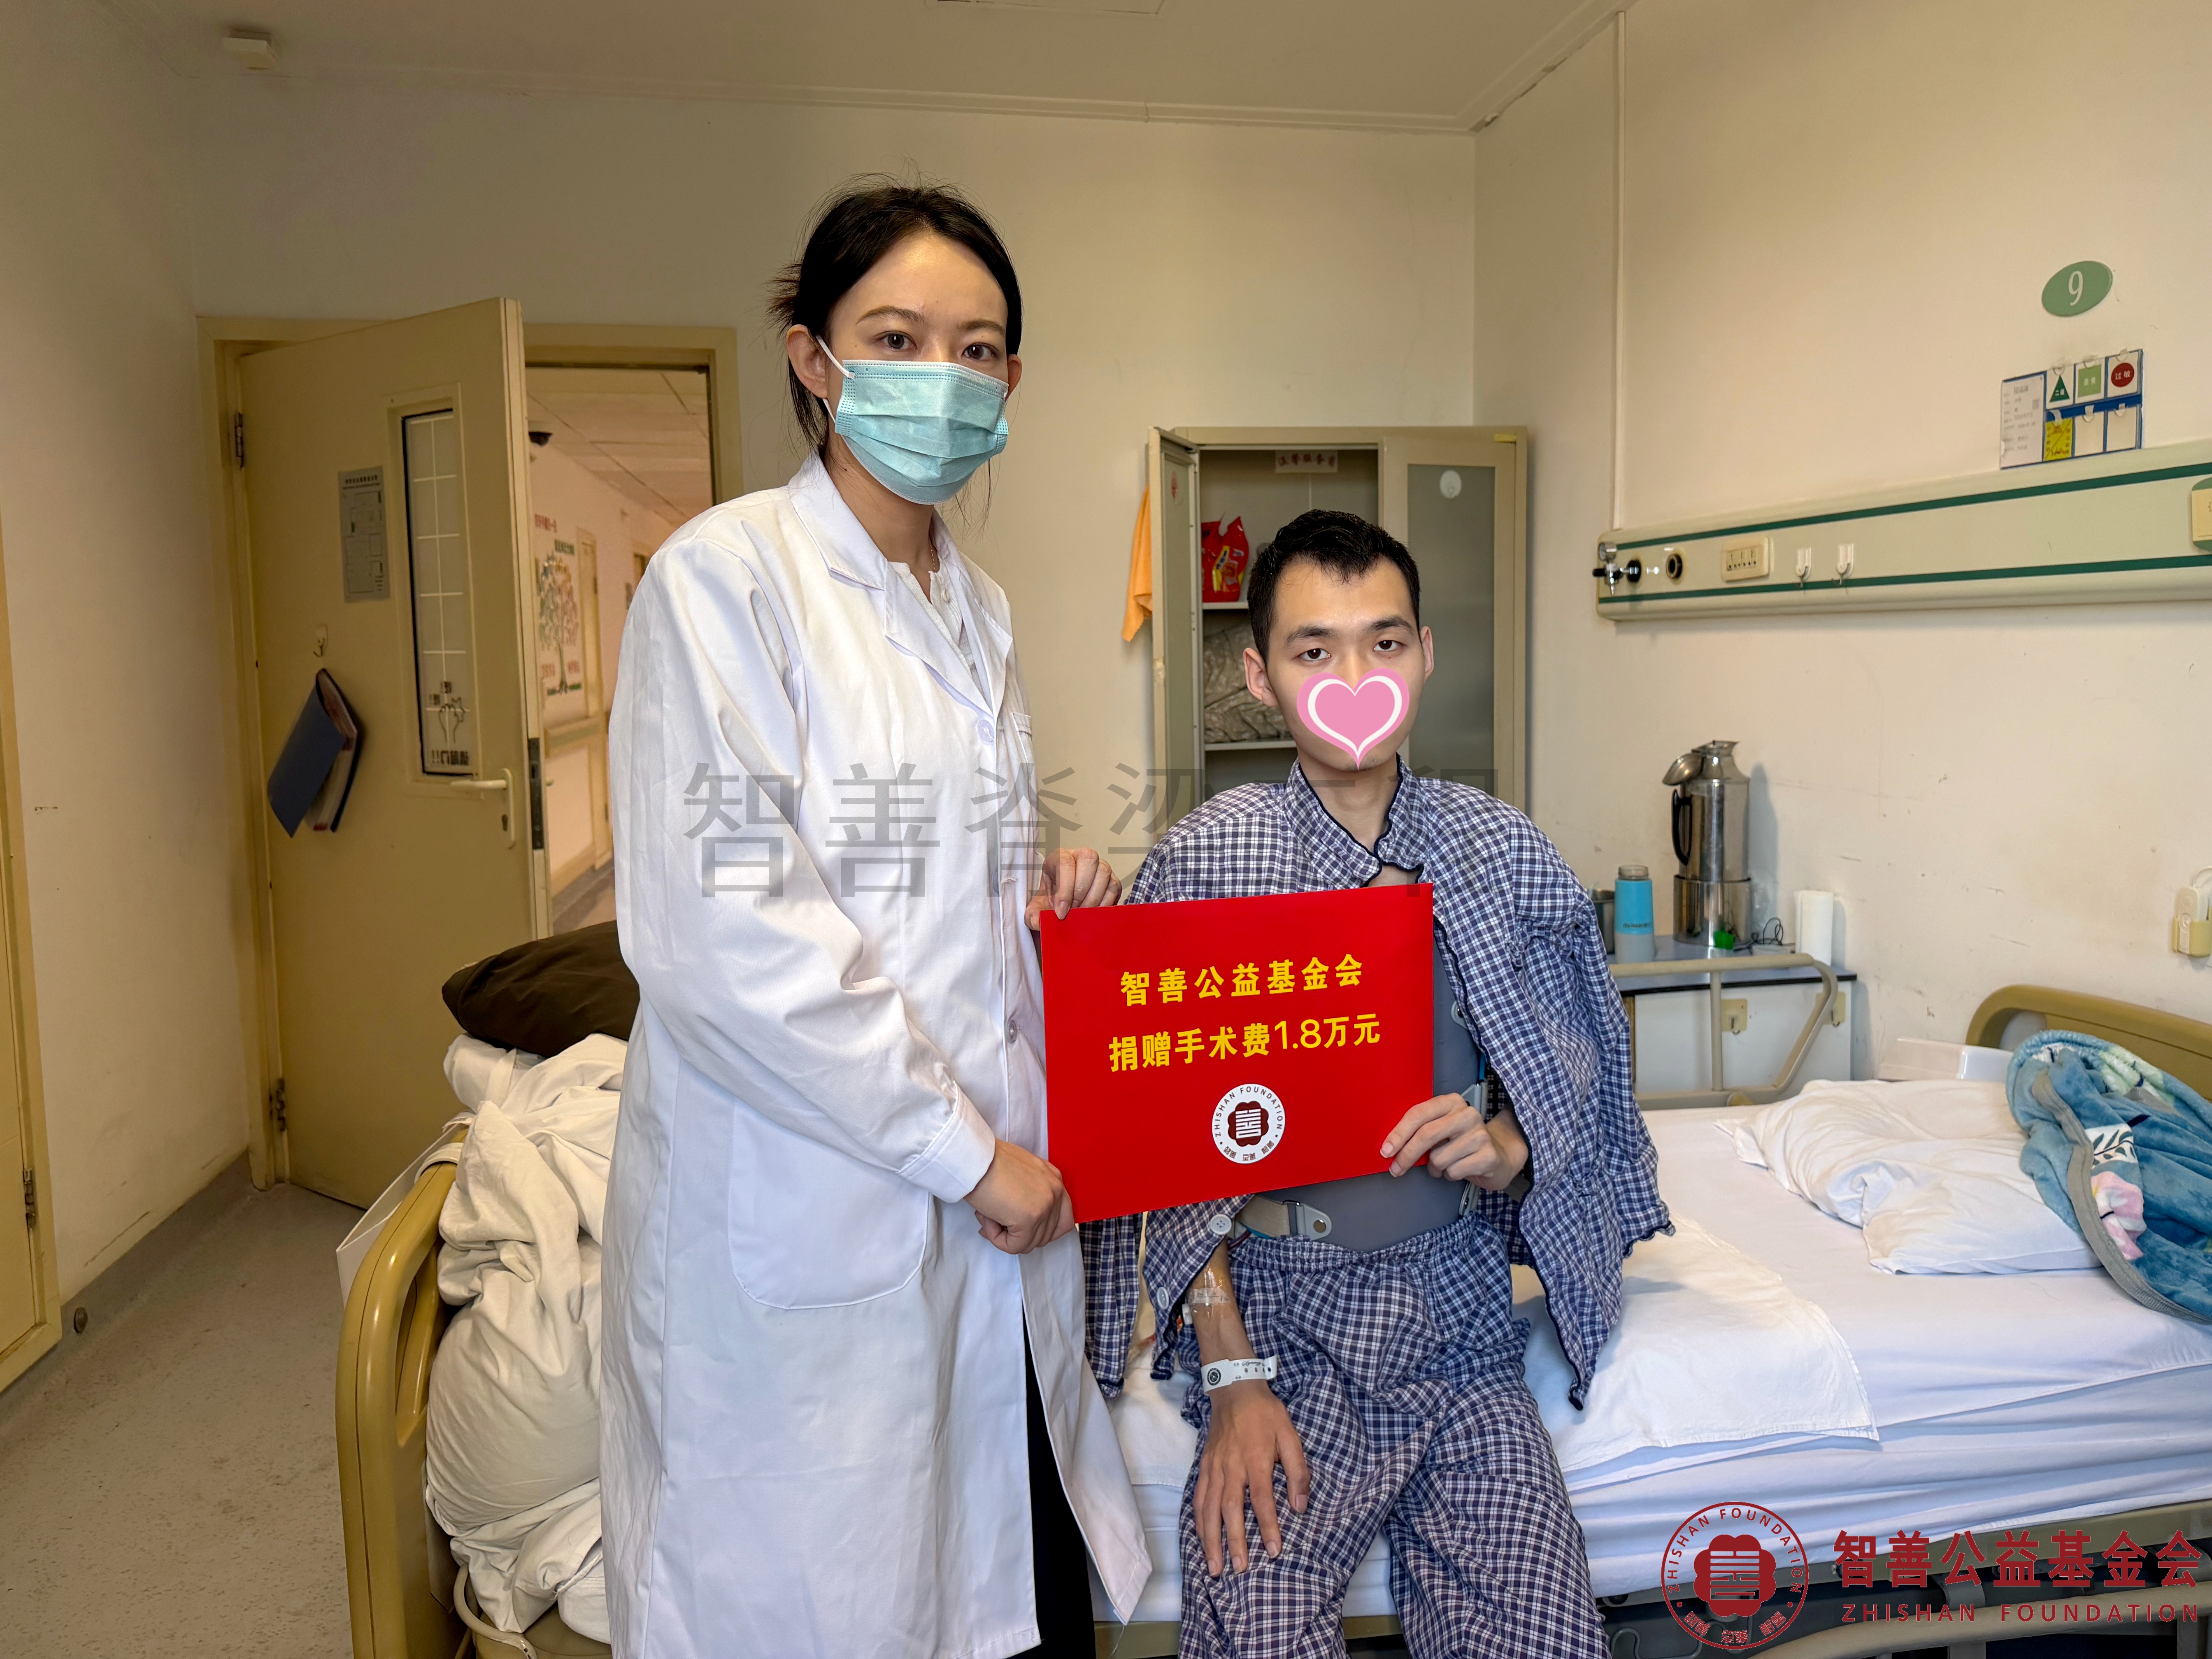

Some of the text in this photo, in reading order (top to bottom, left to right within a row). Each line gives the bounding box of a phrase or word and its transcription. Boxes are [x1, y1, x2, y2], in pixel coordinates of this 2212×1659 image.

[2068, 270, 2084, 307] 9
[1120, 954, 1363, 1007] 智善公益基金会
[1108, 1013, 1380, 1072] 捐赠手术费1.8万元
[1214, 1086, 1283, 1138] ZHISHAN FOUNDATION
